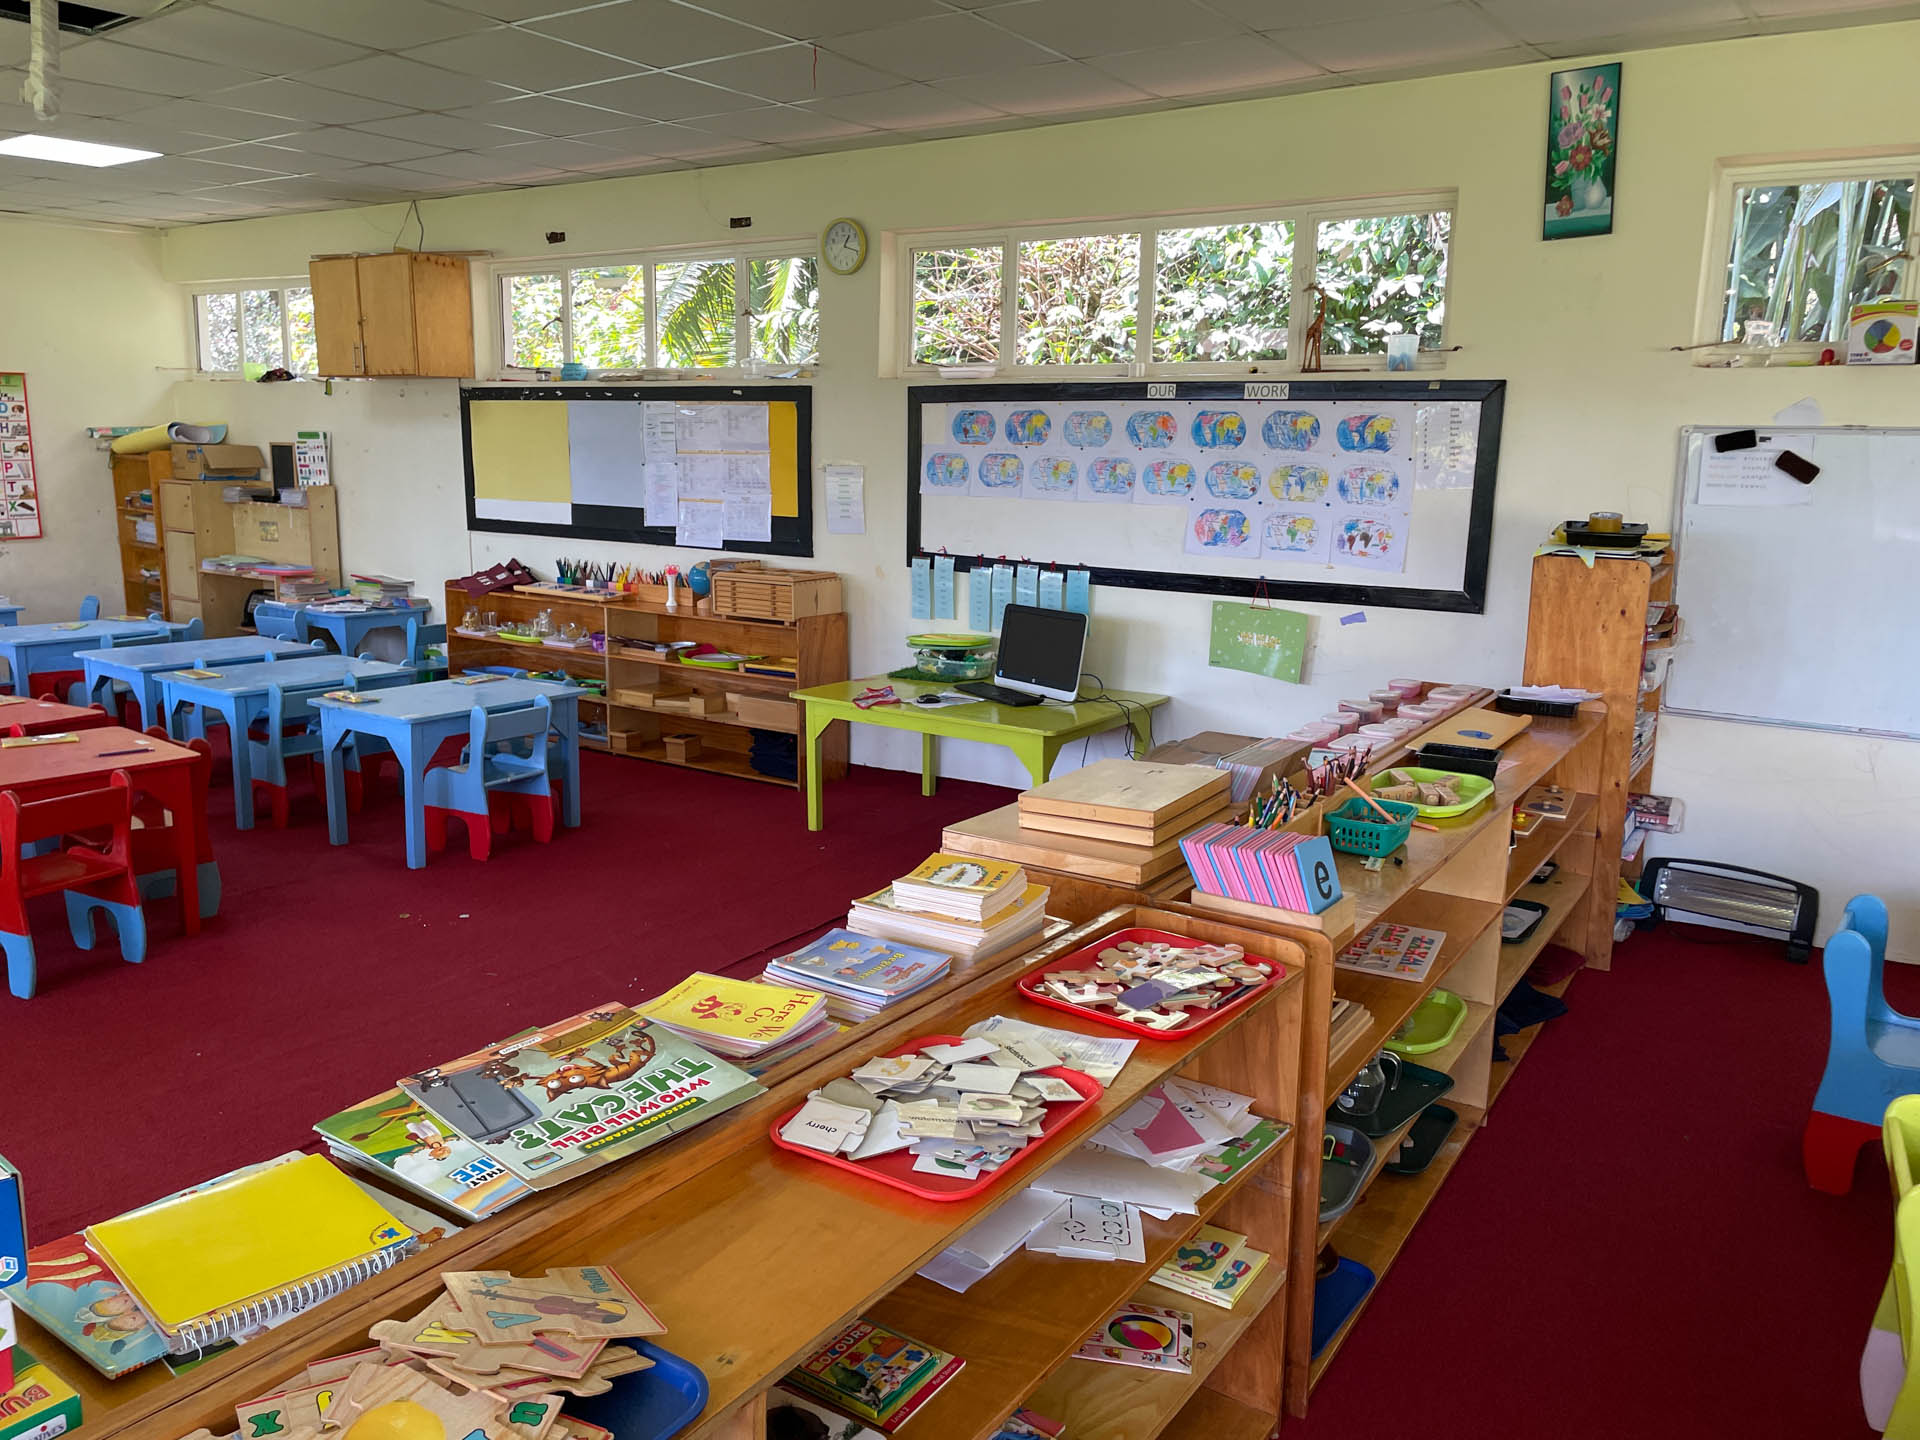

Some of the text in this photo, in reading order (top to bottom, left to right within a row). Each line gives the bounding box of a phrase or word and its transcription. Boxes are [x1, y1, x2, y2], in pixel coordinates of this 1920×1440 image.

[1148, 385, 1288, 398] OUR WORK
[1314, 861, 1332, 900] e
[745, 1008, 775, 1023] Go
[749, 993, 815, 1039] Here We
[511, 1057, 717, 1150] THE CAT?
[549, 1077, 711, 1149] WHO WILL BELL
[585, 1097, 698, 1150] PRESCHOOL READERS
[806, 1121, 837, 1132] cherry
[451, 1157, 496, 1184] IFE
[468, 1167, 506, 1188] THAT
